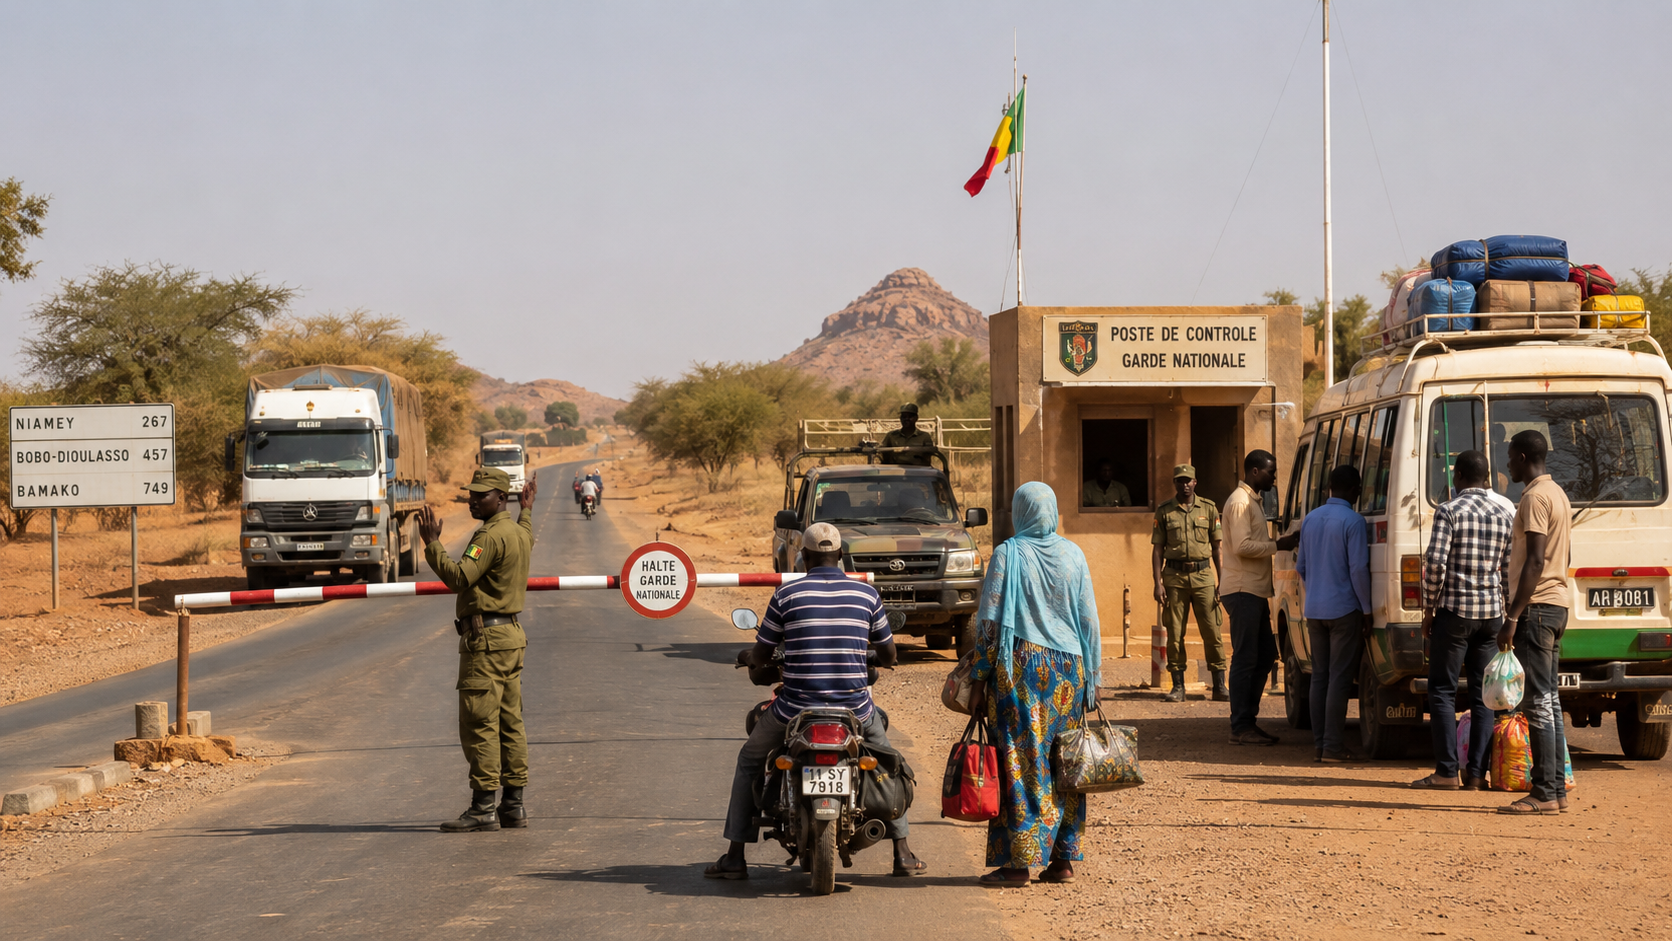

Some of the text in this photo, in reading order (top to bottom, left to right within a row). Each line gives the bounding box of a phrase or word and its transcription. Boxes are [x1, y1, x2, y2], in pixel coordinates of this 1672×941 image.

[1111, 326, 1155, 342] POSTE
[1161, 326, 1179, 342] DE
[1186, 326, 1257, 342] CONTROLE
[1122, 353, 1246, 368] GARDE NATIONALE
[16, 415, 168, 430] NIAMEY 267
[16, 449, 168, 464] BOBO-DIOULASSO 457
[17, 482, 169, 498] BAMAKO 749
[642, 560, 676, 572] HALTE
[640, 575, 677, 586] GARDE
[636, 590, 680, 600] NATIONALE
[809, 768, 846, 781] 11 SY
